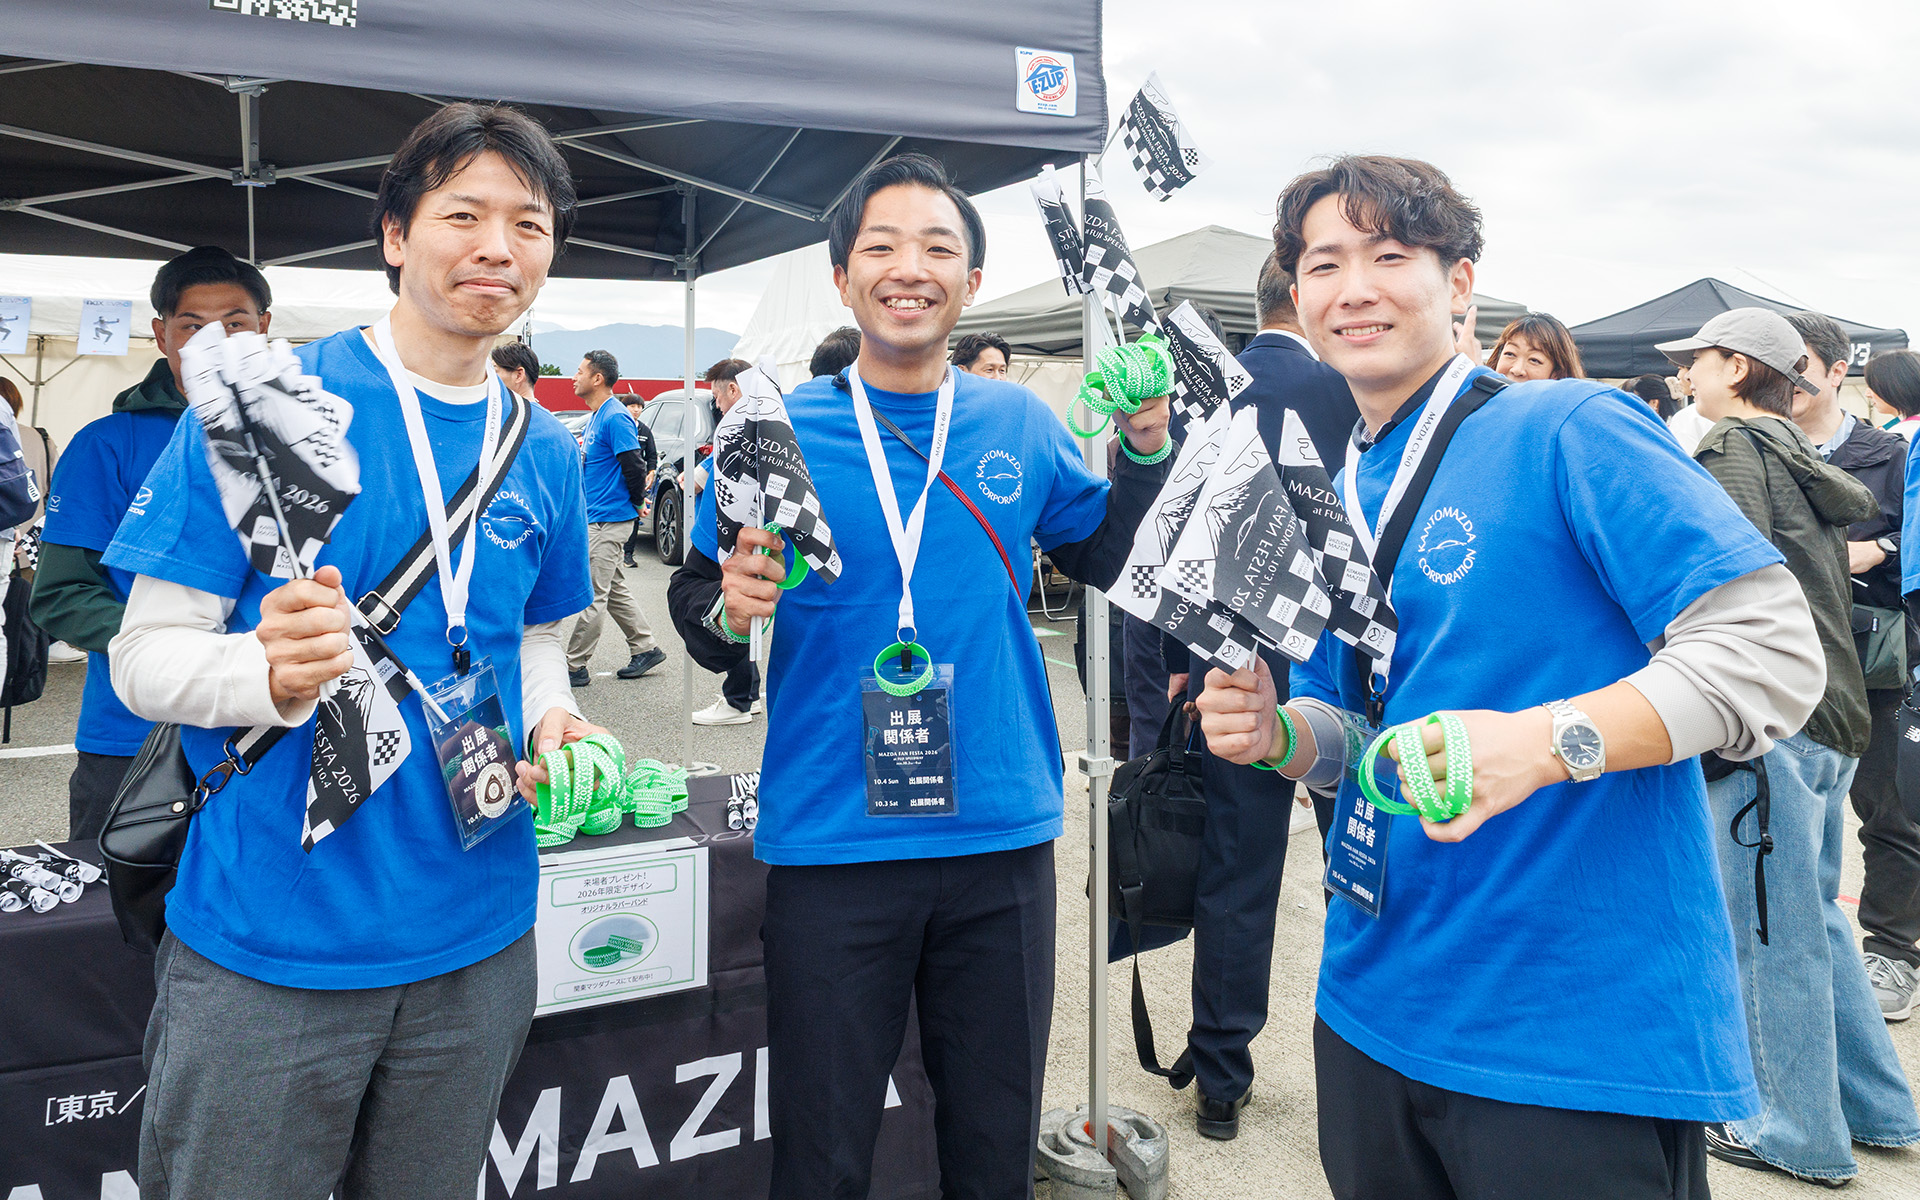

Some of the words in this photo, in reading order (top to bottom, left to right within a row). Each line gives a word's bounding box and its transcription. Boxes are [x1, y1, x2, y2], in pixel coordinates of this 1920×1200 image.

[1145, 122, 1156, 140] FAN
[1153, 140, 1170, 164] FESTA
[1168, 164, 1188, 182] 2026
[1165, 326, 1184, 361] MAZDA
[1181, 359, 1196, 376] FAN
[1193, 374, 1212, 397] FESTA
[1418, 411, 1436, 441] MAZDA
[768, 455, 784, 468] FUJI
[976, 450, 1022, 478] KANTOMAZDA
[1404, 442, 1420, 468] CX-60
[281, 484, 331, 515] 2026
[978, 481, 1022, 504] CORPORATION
[1312, 507, 1322, 516] at
[1324, 508, 1344, 522] FUJI
[482, 522, 534, 550] CORPORATION
[1418, 506, 1476, 552] KANTOMAZDA
[1328, 542, 1349, 552] MAZDA
[1346, 573, 1367, 584] MAZDA
[1418, 548, 1476, 585] CORPORATION
[890, 710, 922, 726] 出展
[461, 726, 488, 755] 出展
[884, 728, 930, 745] 関係者
[315, 720, 338, 767] FESTA
[332, 766, 360, 804] 2026
[462, 742, 498, 778] 関係者
[1456, 746, 1466, 782] MAZDA
[908, 776, 944, 785] 出展関係者
[1411, 762, 1428, 798] MAZDA
[910, 797, 946, 807] 出展関係者
[1354, 796, 1376, 824] 出展
[1346, 816, 1376, 848] 関係者
[578, 882, 652, 898] 2026年限定デザイン
[581, 898, 648, 914] オリジナルラバーバンド
